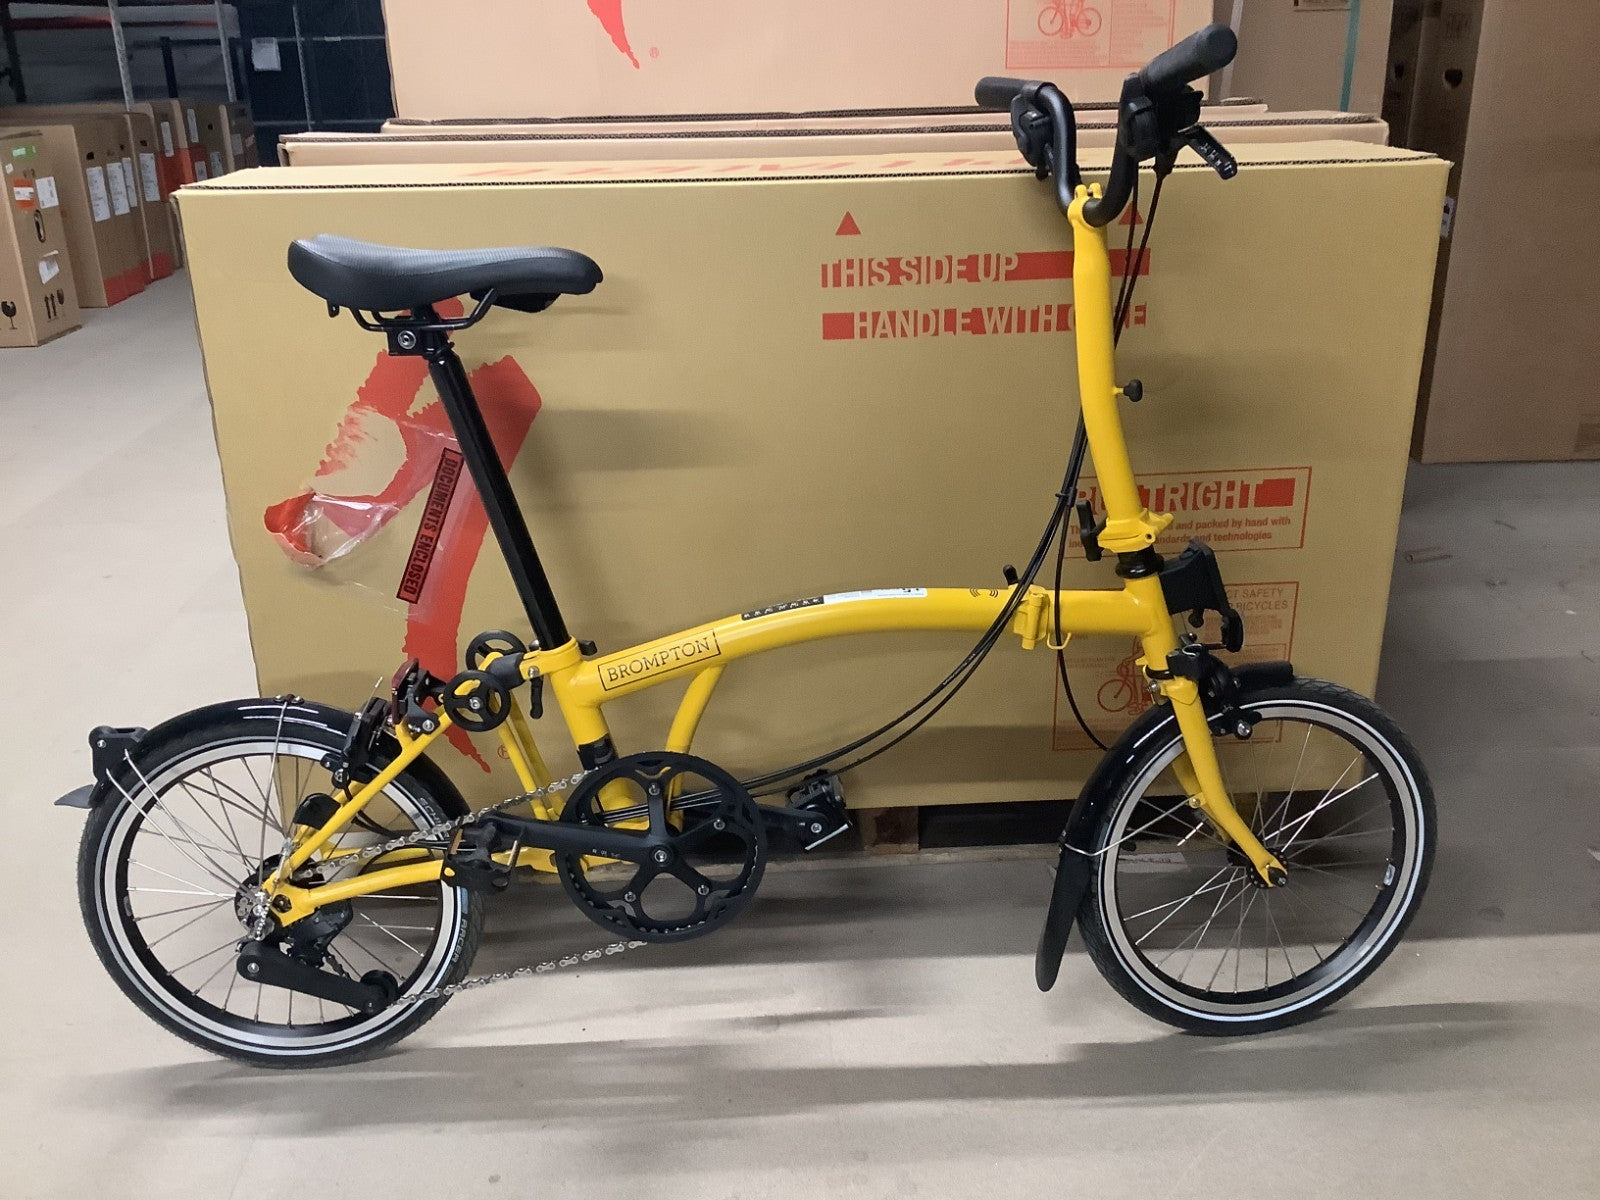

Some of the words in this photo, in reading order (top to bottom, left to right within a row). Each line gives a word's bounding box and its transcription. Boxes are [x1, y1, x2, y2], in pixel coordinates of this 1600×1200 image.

[822, 257, 891, 288] THIS
[899, 254, 968, 286] SIDE
[978, 252, 1019, 283] UP
[854, 307, 972, 340] HANDLE
[982, 304, 1058, 335] WITH
[423, 456, 460, 534] DOCUMENTS
[1196, 518, 1229, 531] packed
[1231, 518, 1243, 530] by
[1245, 517, 1269, 527] hand
[1271, 516, 1291, 526] with
[1213, 530, 1273, 543] technologies
[402, 532, 435, 596] ENCLOSED
[1242, 587, 1283, 599] SAFETY
[607, 636, 710, 683] BROMPTON
